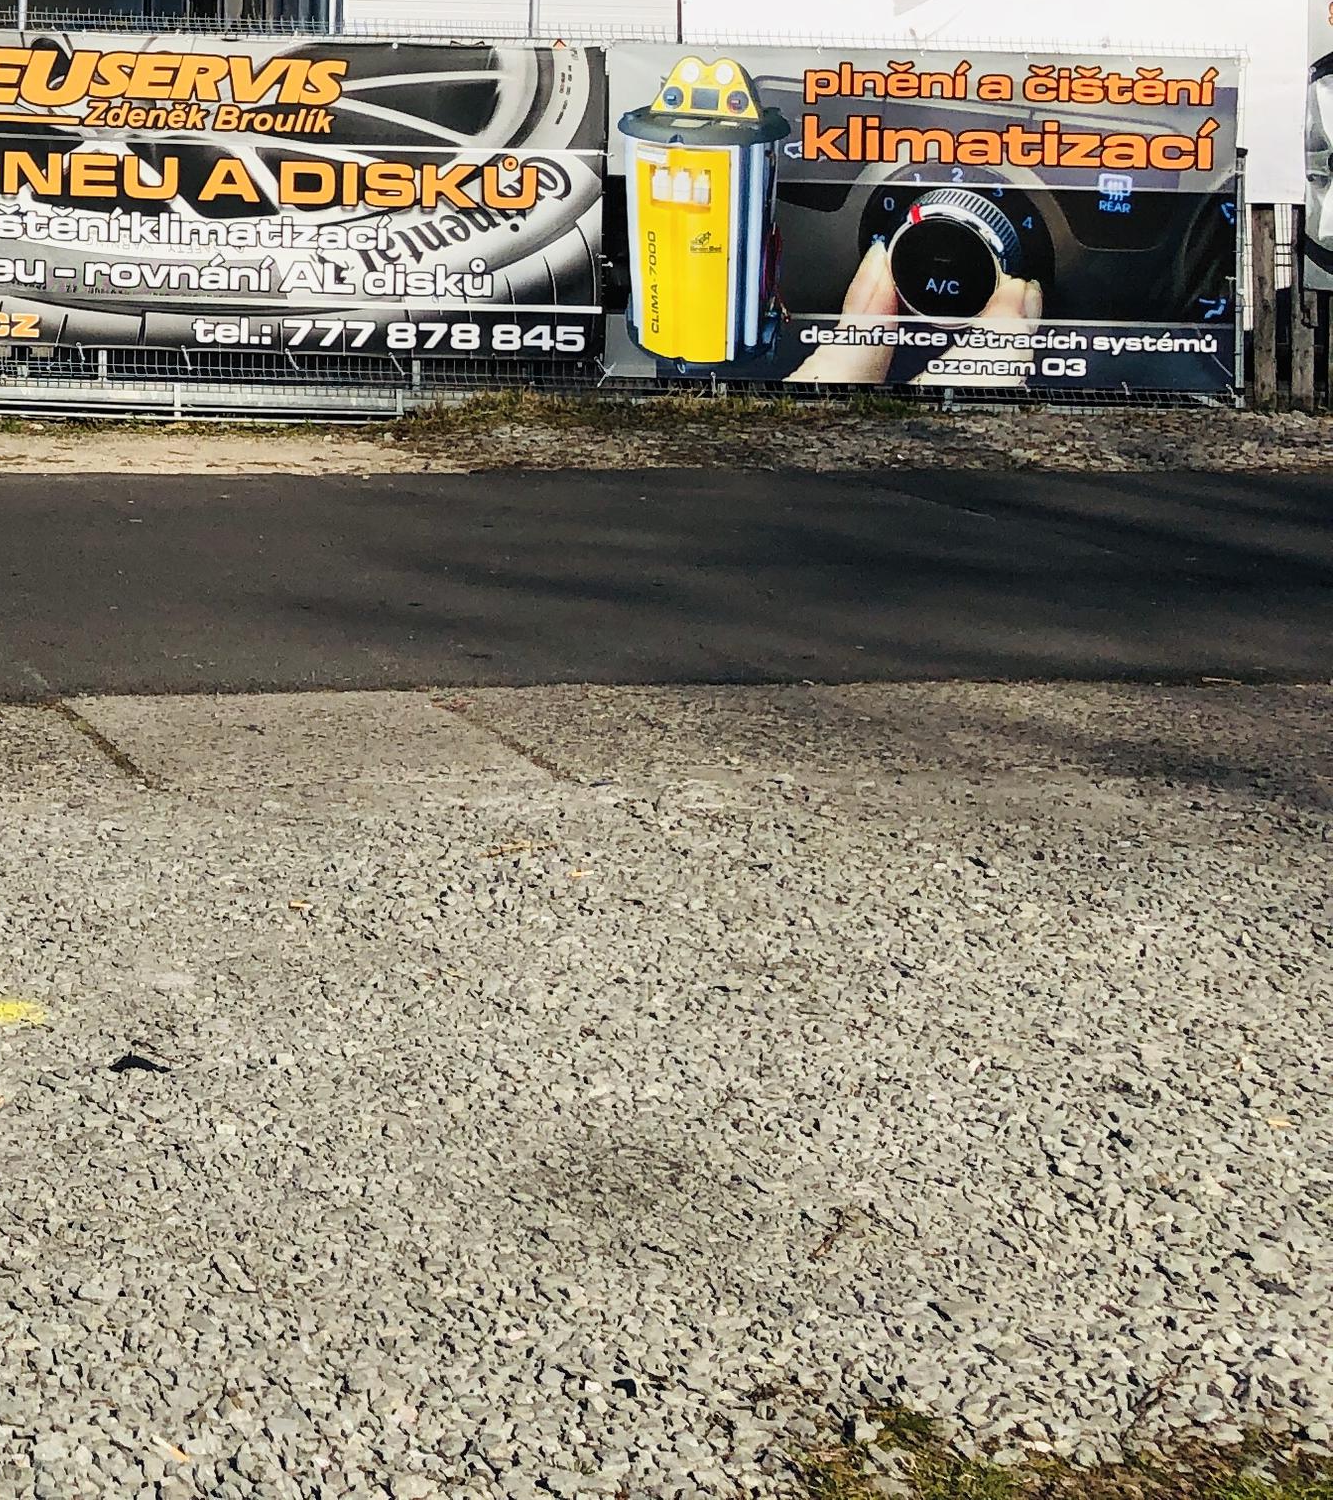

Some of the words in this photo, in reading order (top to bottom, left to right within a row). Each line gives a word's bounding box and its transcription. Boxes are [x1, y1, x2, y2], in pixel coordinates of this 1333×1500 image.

[802, 60, 972, 102] plnění
[977, 69, 1013, 102] a
[1022, 63, 1219, 107] čištění
[83, 100, 204, 130] Zdeněk
[213, 103, 336, 135] Broulík
[801, 113, 1221, 172] klimatizací
[199, 157, 262, 202] A
[279, 155, 539, 212] DISKŮ
[951, 168, 964, 183] 2
[1022, 216, 1033, 229] 4
[1098, 201, 1131, 213] REAR
[130, 211, 392, 252] klimatizací
[83, 259, 273, 293] rovnání
[279, 260, 355, 295] AL
[362, 257, 495, 299] disků
[925, 277, 961, 295] A/C
[191, 317, 272, 346] tel.:
[281, 318, 376, 350] 777
[385, 321, 482, 352] 878
[491, 324, 586, 354] 845
[799, 325, 948, 350] dezinfekce
[953, 326, 1088, 352] větracích
[1091, 330, 1218, 355] systémů
[925, 357, 1036, 378] ozonem
